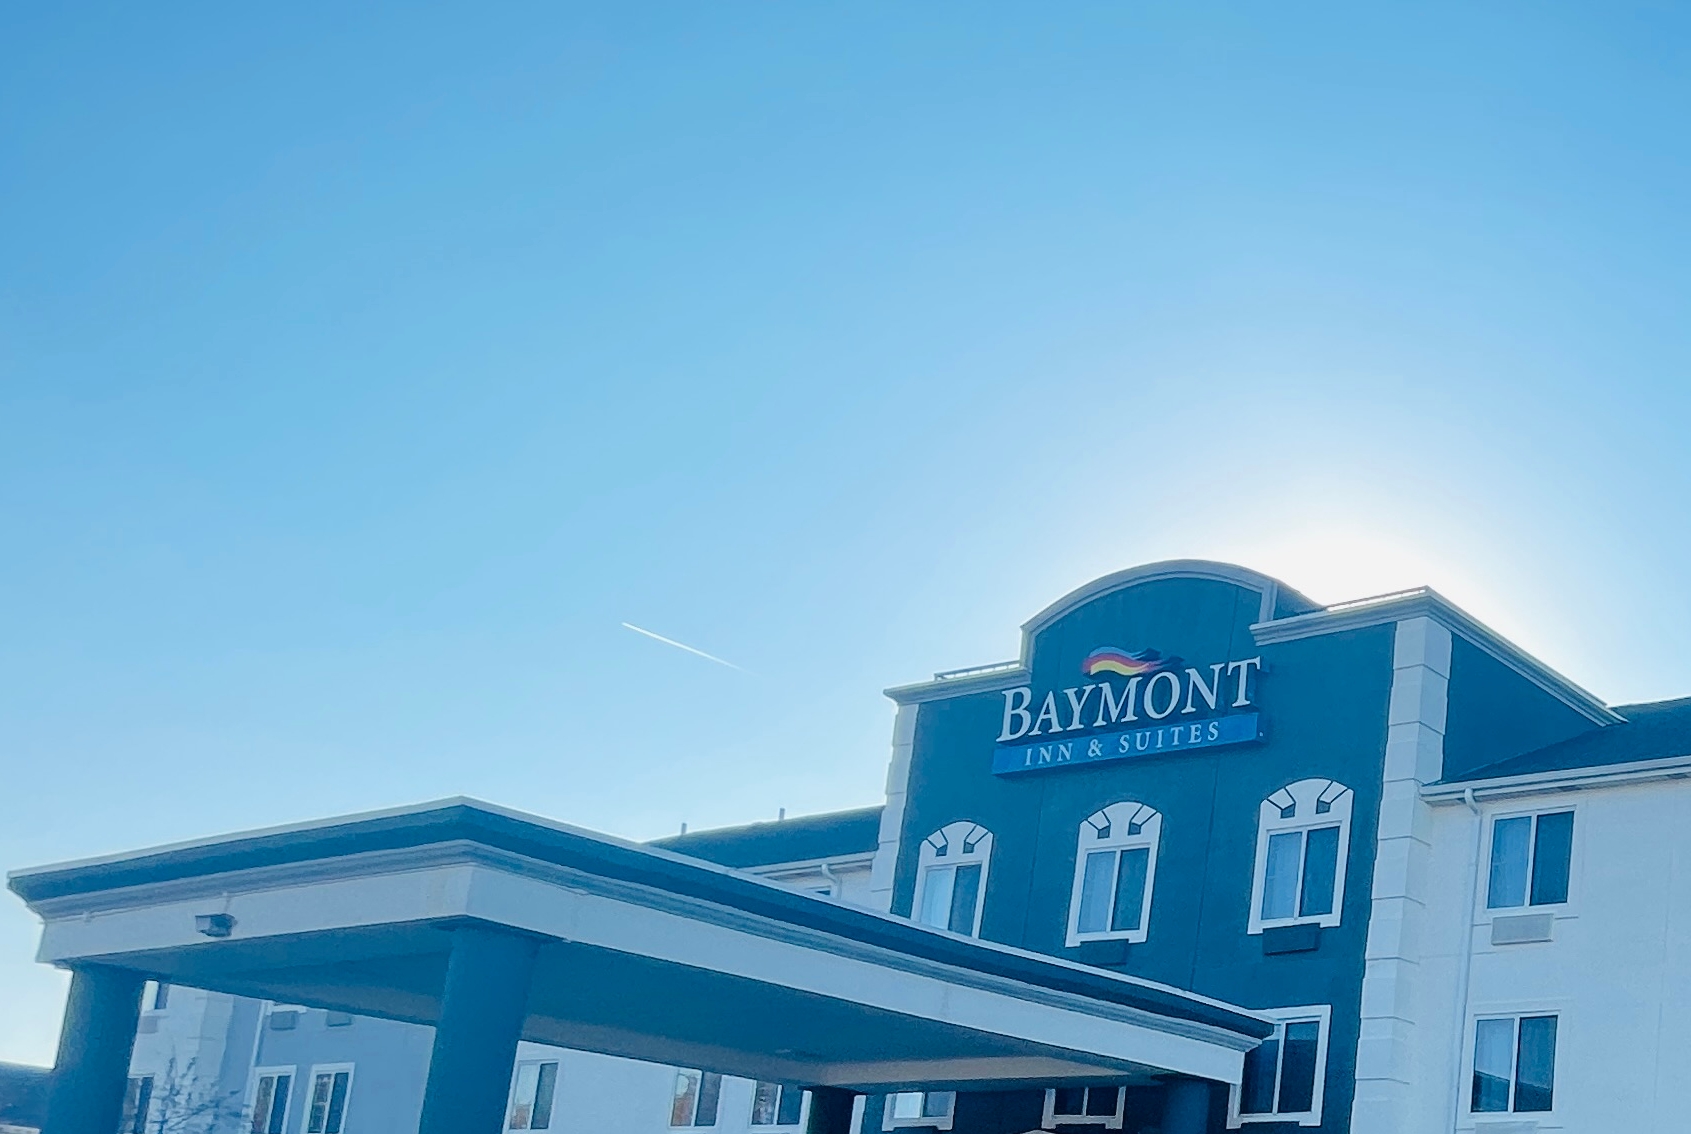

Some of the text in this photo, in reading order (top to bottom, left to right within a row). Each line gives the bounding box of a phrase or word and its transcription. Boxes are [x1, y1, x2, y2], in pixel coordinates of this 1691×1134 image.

[996, 656, 1261, 742] BAYMONT
[1025, 721, 1219, 766] INN & SUITES
